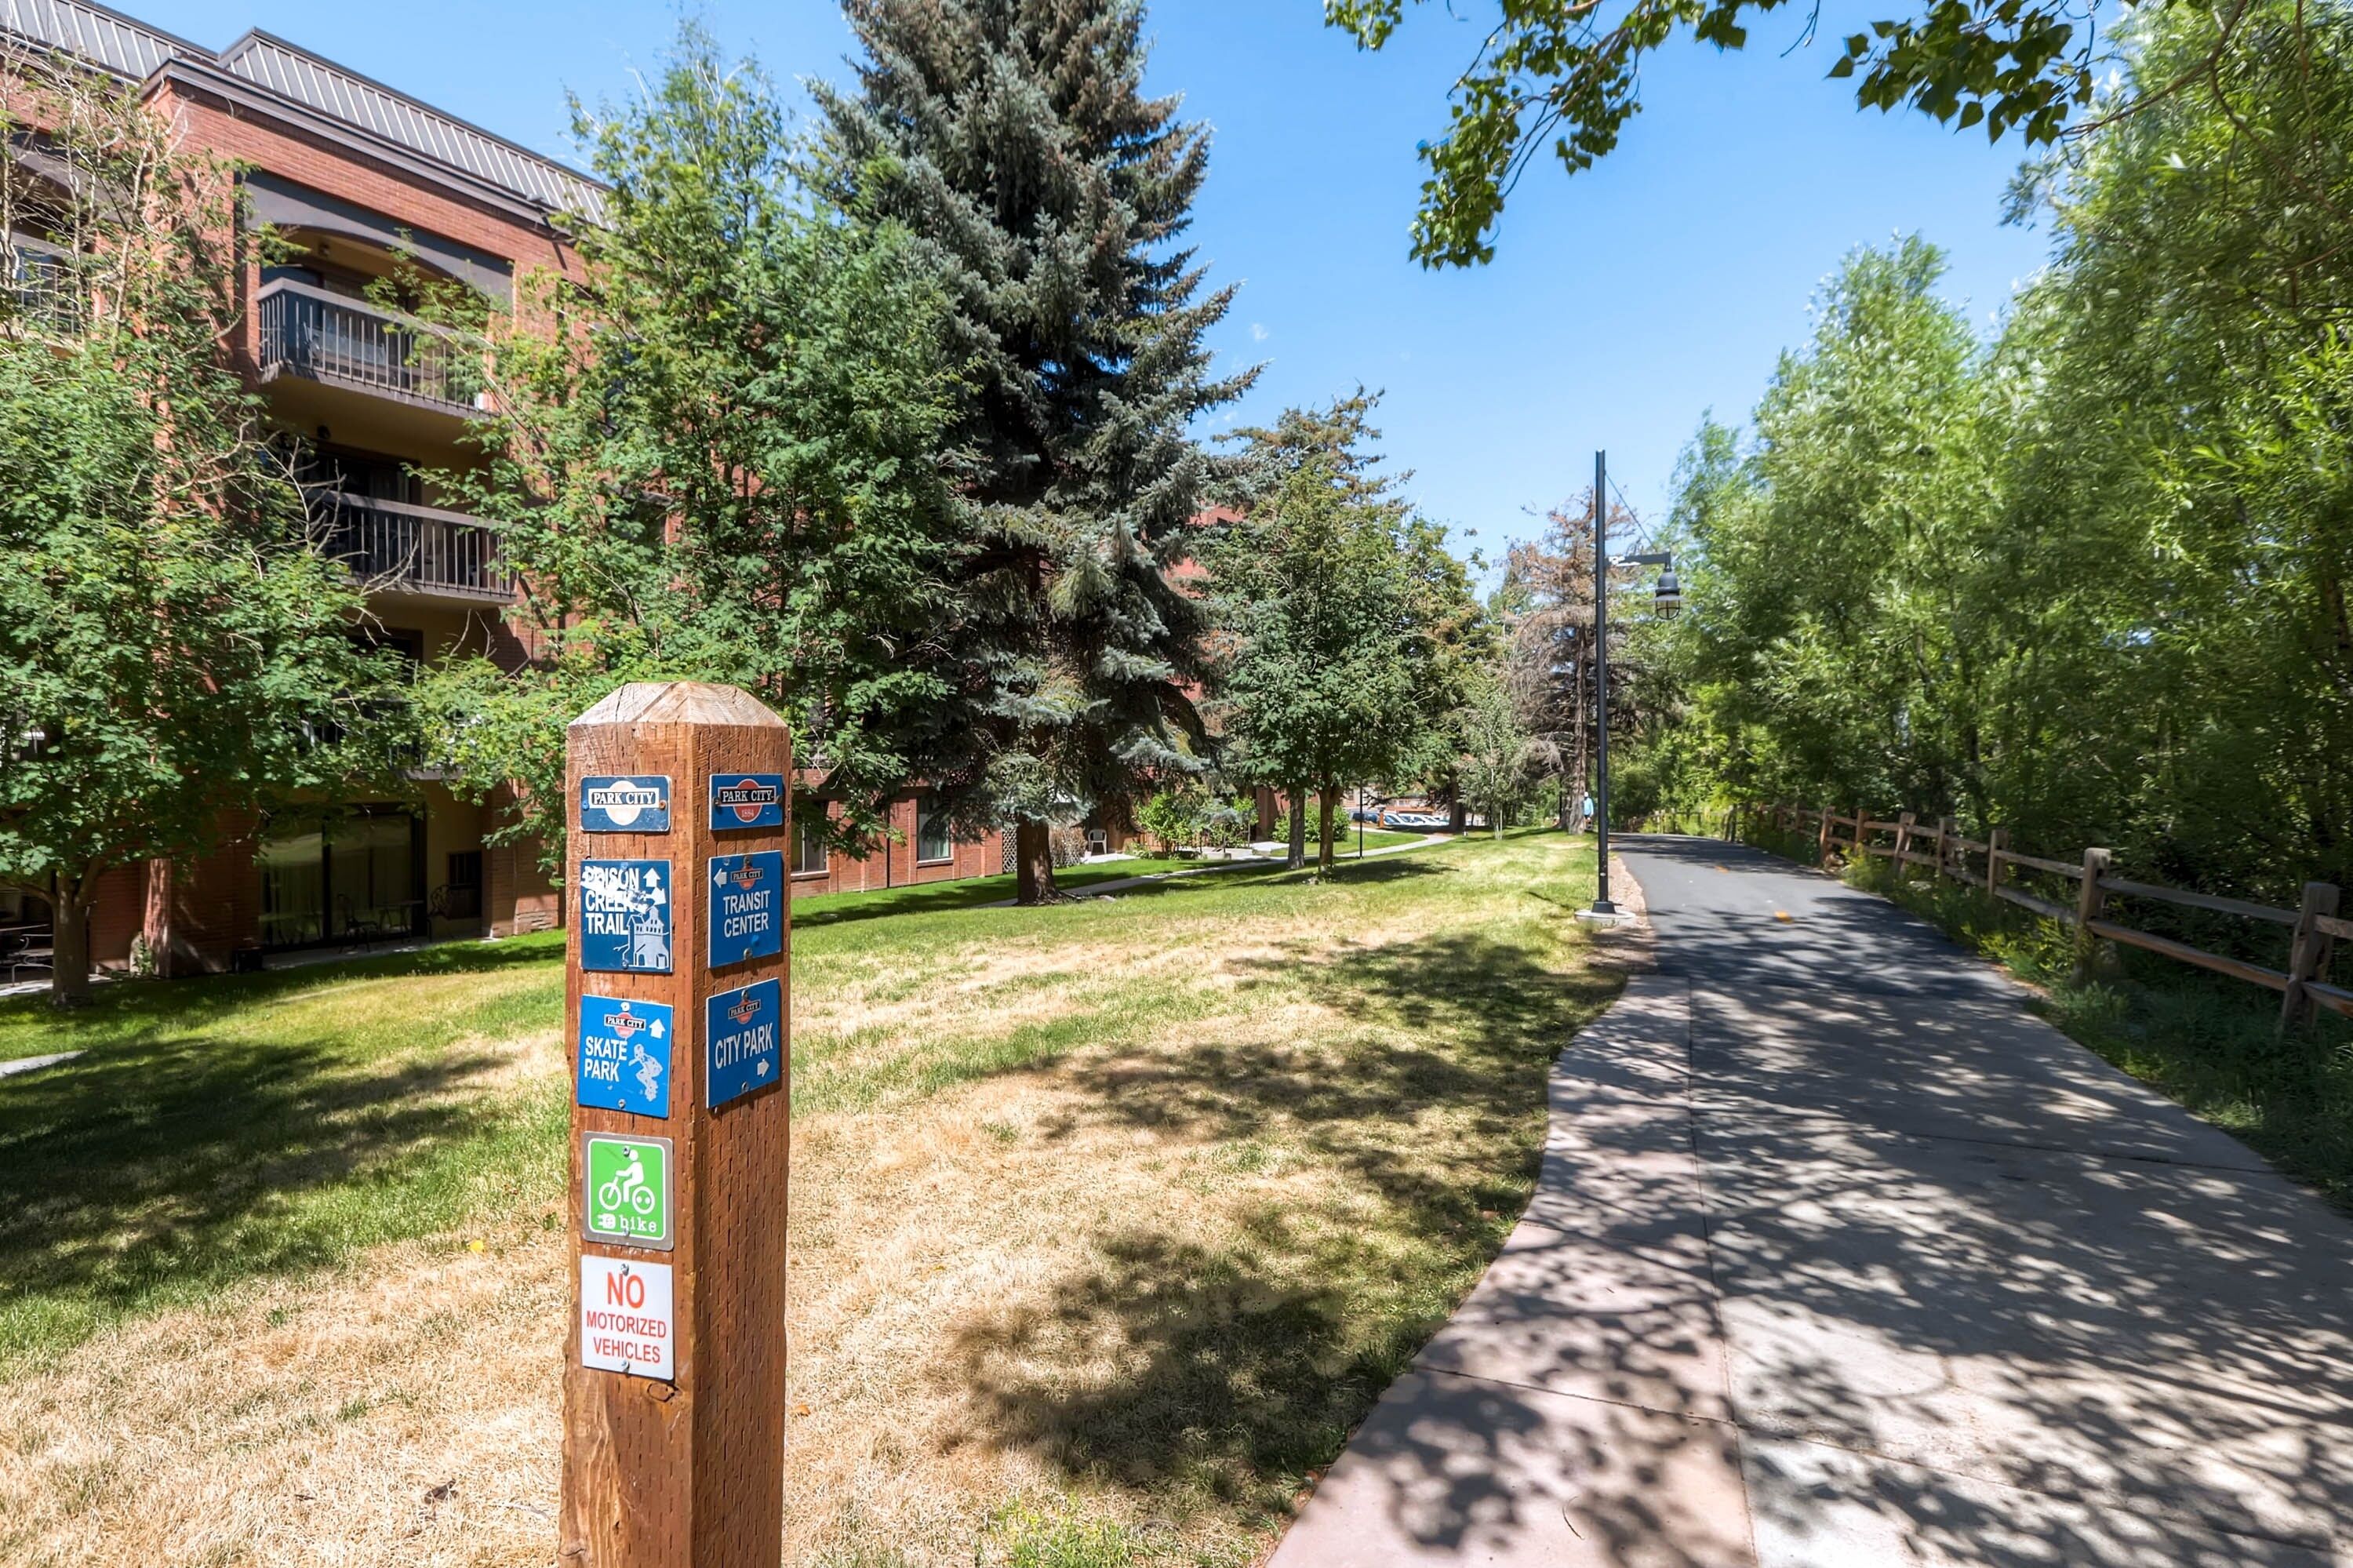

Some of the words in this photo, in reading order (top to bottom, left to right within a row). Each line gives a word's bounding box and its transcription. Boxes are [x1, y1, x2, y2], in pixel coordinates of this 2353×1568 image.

[594, 792, 623, 805] PARK
[626, 791, 653, 804] CITY
[722, 791, 748, 802] PARK
[751, 790, 773, 801] CITY
[723, 890, 771, 915] TRANSIT
[585, 913, 628, 935] TRAIL
[724, 912, 769, 937] CENTER
[607, 1017, 625, 1026] PARK
[627, 1020, 643, 1028] CITY
[585, 1036, 627, 1060] SKATE
[715, 1033, 741, 1069] CITY
[744, 1023, 773, 1059] PARK
[584, 1058, 620, 1082] PARK
[607, 1271, 645, 1308] NO
[587, 1311, 667, 1338] MOTORIZED
[594, 1337, 660, 1363] VEHICLES
